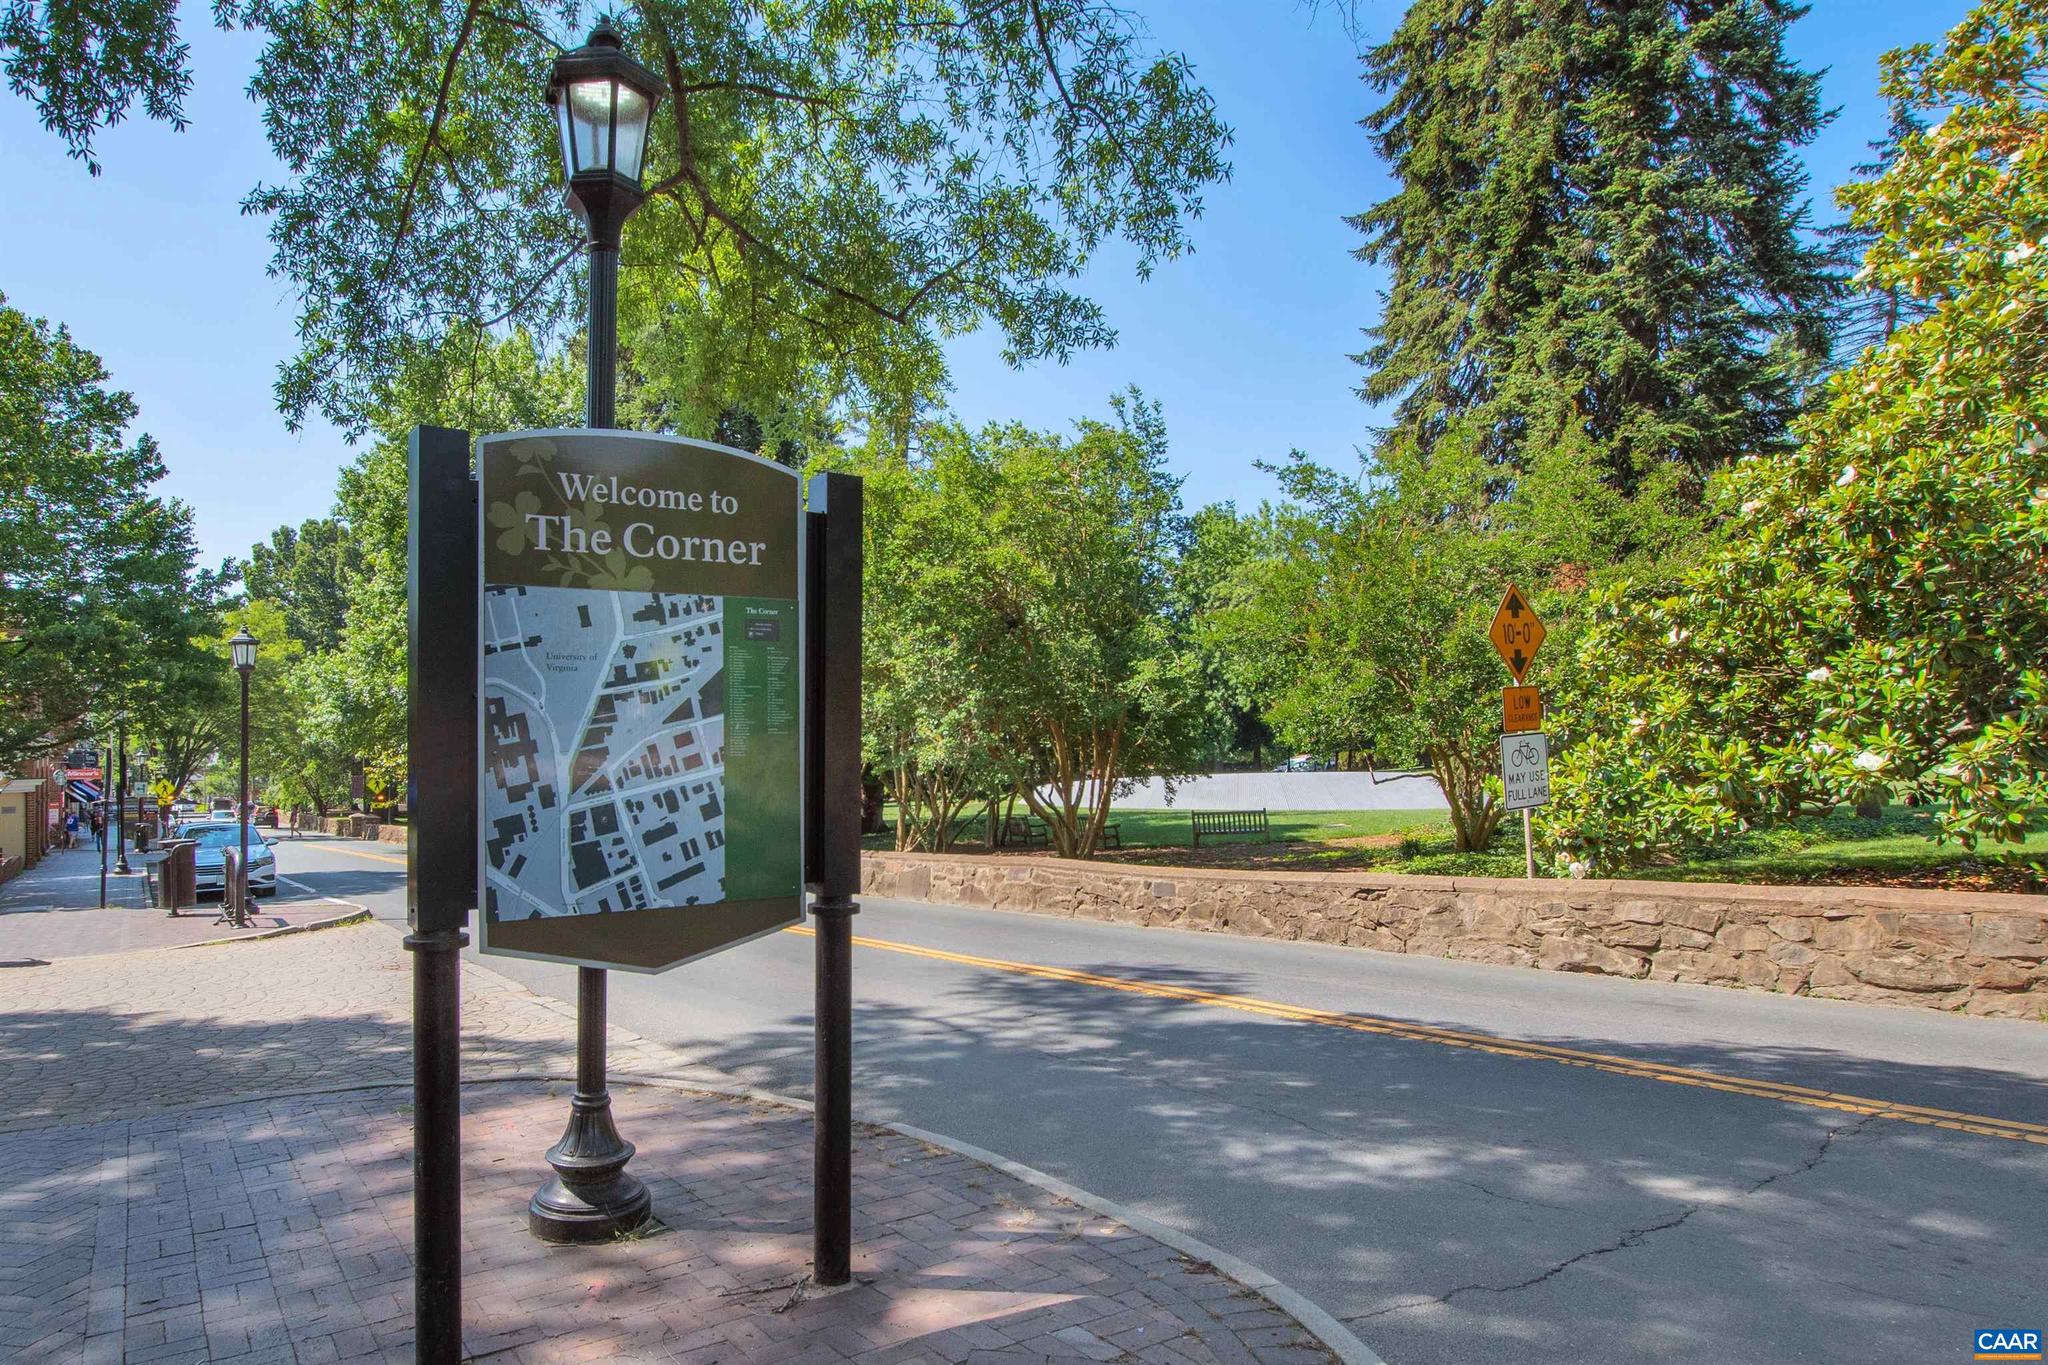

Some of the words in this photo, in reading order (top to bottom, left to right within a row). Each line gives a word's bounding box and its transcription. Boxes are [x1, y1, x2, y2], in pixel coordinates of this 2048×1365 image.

[557, 472, 703, 511] Welcome
[711, 489, 738, 515] to
[525, 513, 612, 554] The
[623, 523, 766, 565] Corner
[546, 652, 587, 661] University
[546, 663, 578, 672] Virginia
[1513, 696, 1531, 710] LOW
[1508, 712, 1539, 722] CLEARANCE
[1508, 773, 1526, 784] MAY
[1529, 770, 1546, 781] USE
[1508, 789, 1527, 801] FULL
[1528, 785, 1548, 799] LANE
